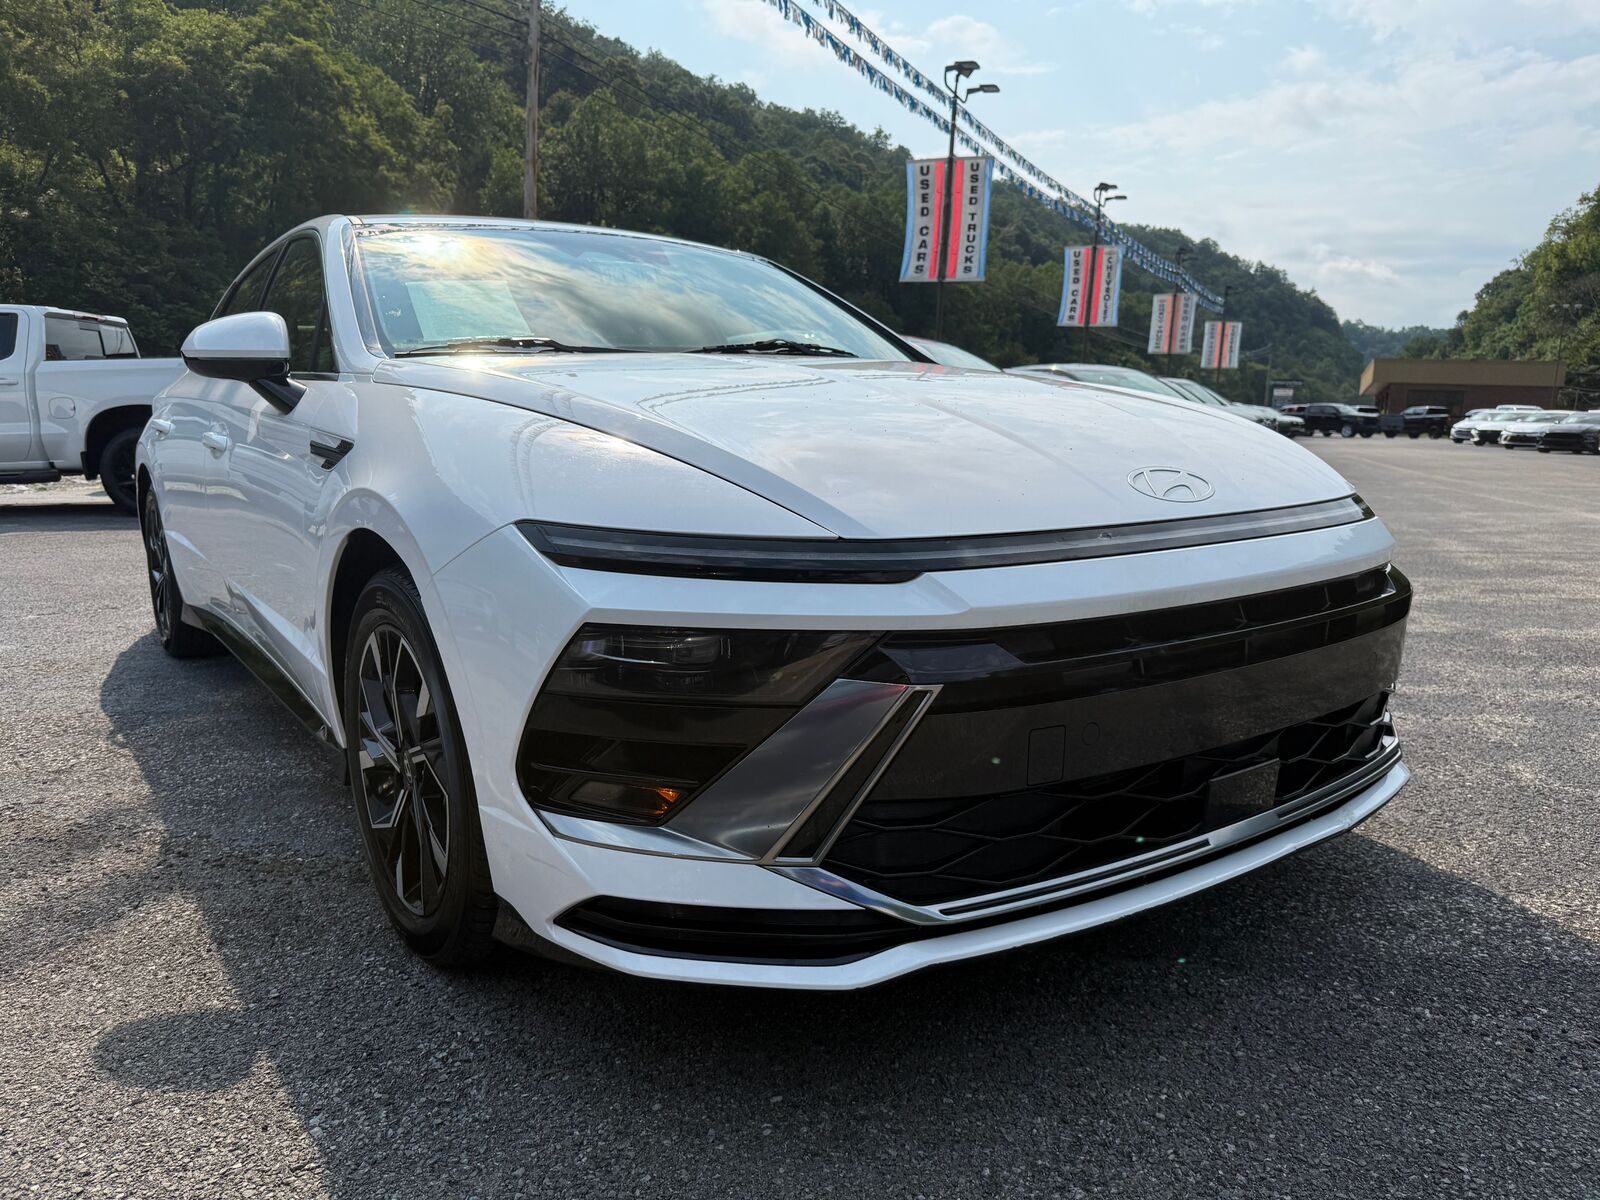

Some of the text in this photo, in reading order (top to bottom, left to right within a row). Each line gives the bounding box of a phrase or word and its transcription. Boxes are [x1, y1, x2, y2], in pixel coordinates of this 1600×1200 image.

[914, 166, 930, 273] USED CARS
[963, 163, 979, 273] USED TRUCKS
[1068, 250, 1081, 322] USED CARS
[1103, 256, 1113, 323] CHEVROLET
